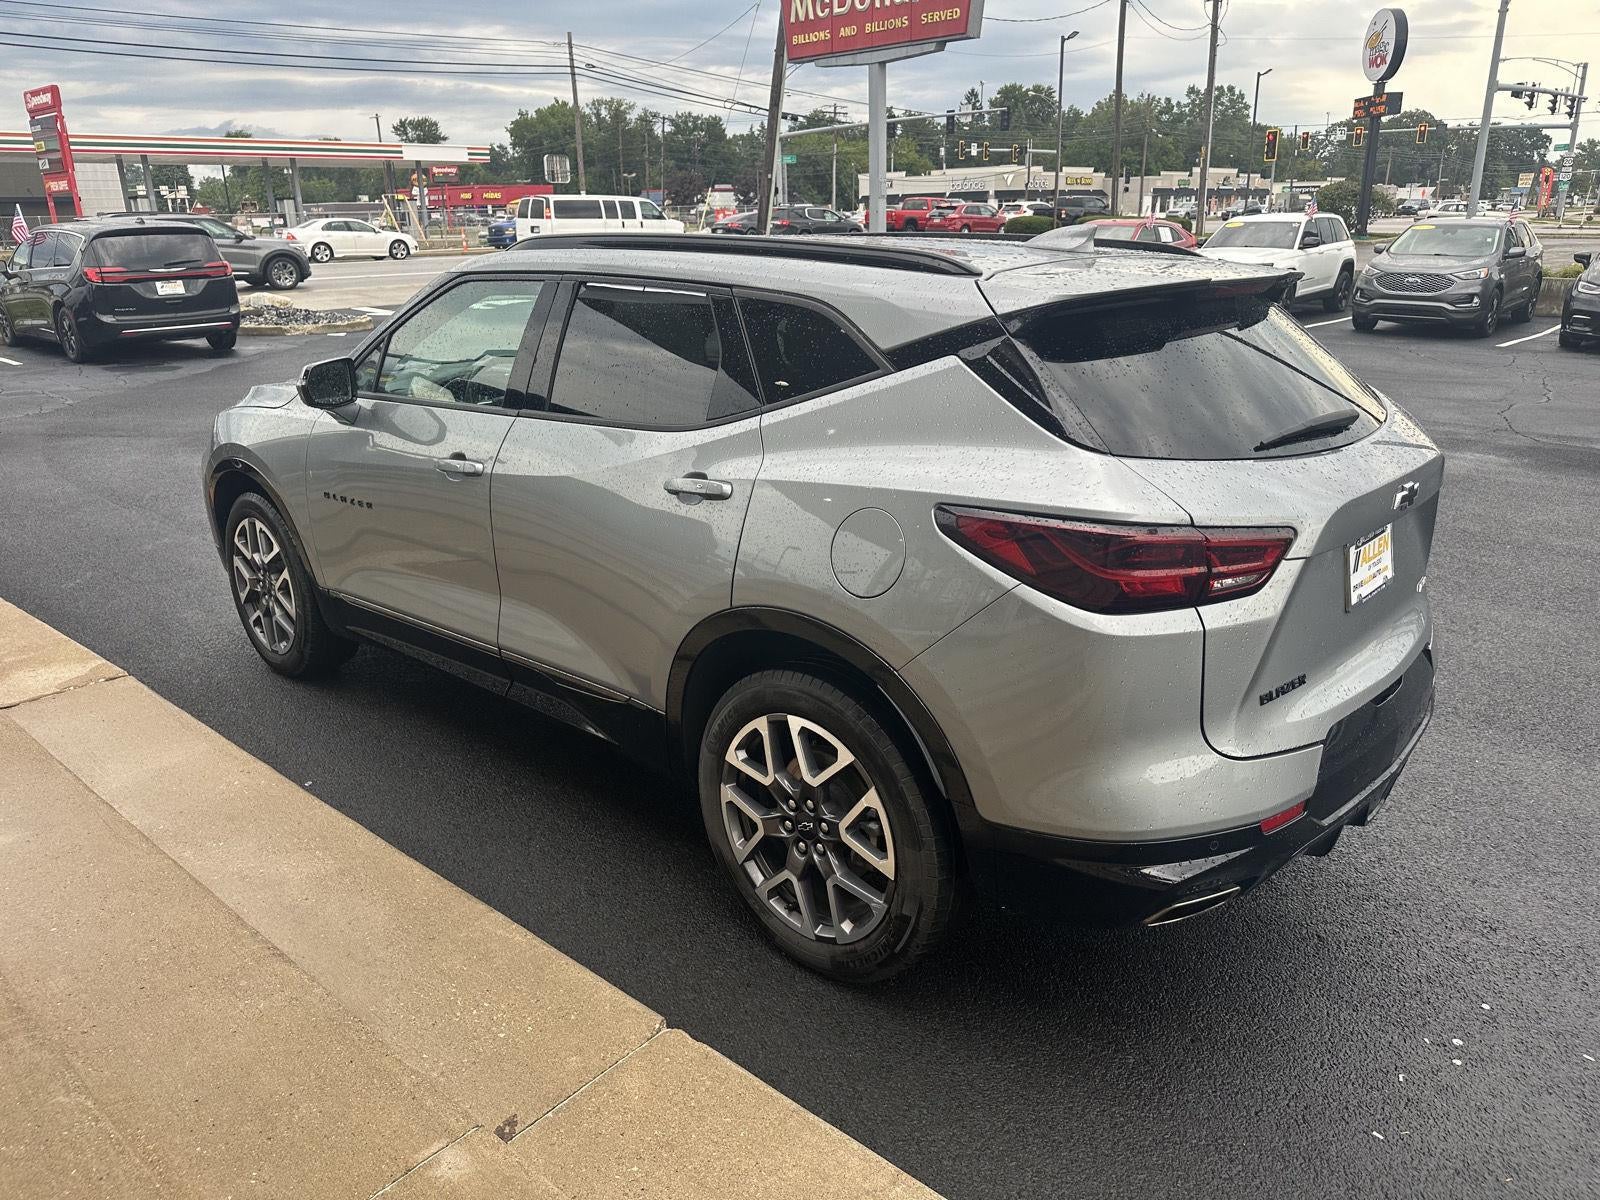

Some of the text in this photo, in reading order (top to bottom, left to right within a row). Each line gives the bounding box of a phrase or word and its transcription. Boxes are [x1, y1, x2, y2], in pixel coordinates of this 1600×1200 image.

[789, 0, 919, 24] McDon
[792, 7, 961, 45] BILLIONS AND BILLIONS SERVED
[1368, 53, 1389, 69] WOK
[26, 91, 52, 109] Speedway
[432, 166, 458, 174] Speedway
[1564, 158, 1573, 166] 20
[323, 491, 373, 509] BLAZER
[1361, 531, 1390, 567] ALLEN
[1259, 673, 1307, 706] BLAZER
